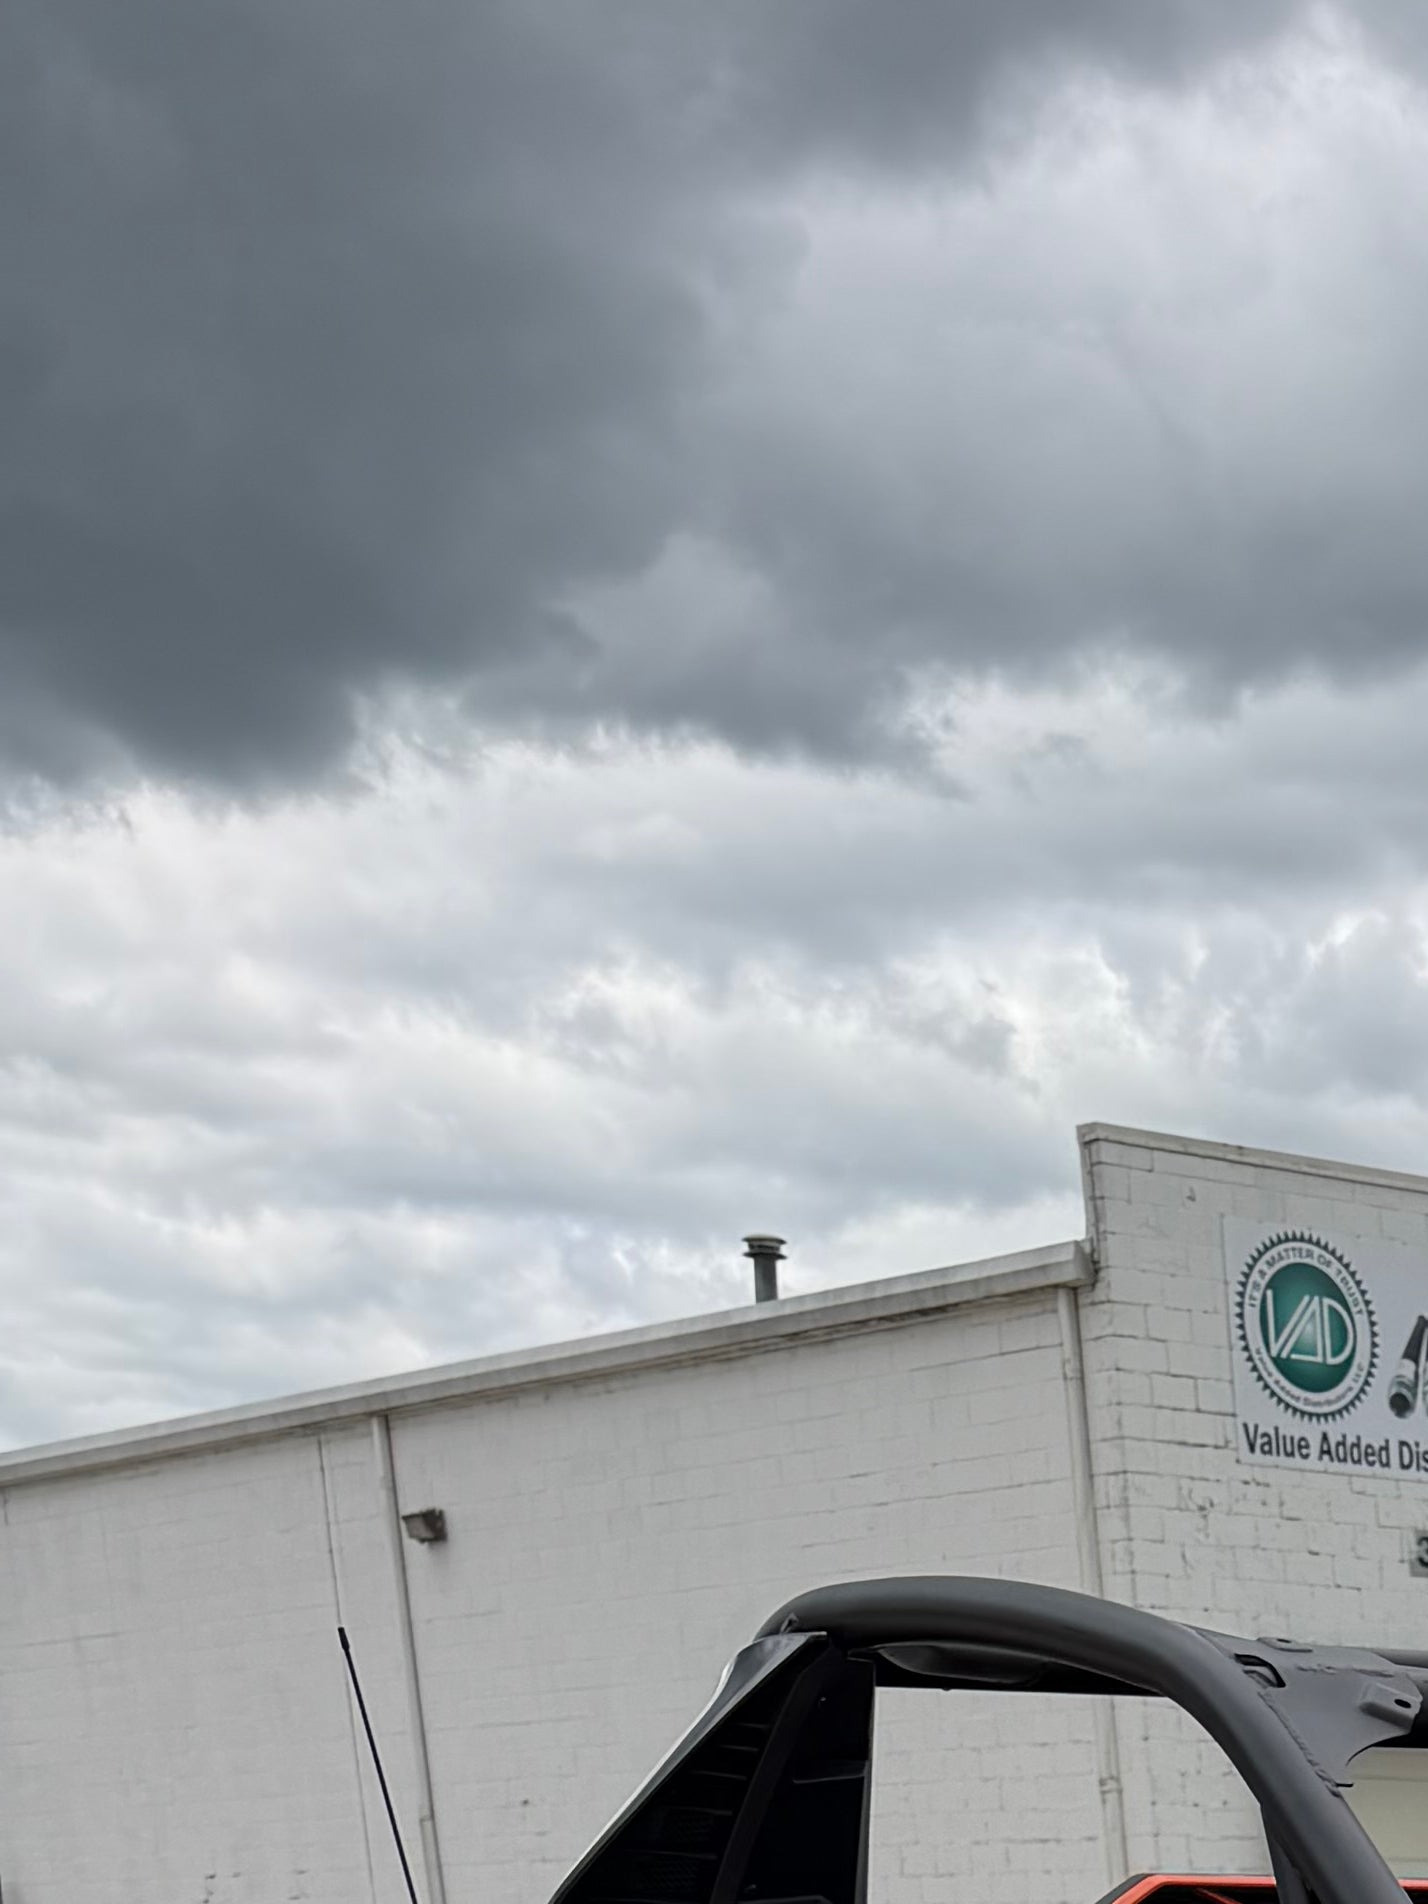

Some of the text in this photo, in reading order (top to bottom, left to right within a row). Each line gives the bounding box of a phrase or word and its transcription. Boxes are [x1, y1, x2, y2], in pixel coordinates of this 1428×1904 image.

[1266, 1288, 1355, 1365] VAD
[1242, 1422, 1311, 1460] Value
[1318, 1431, 1391, 1468] Added
